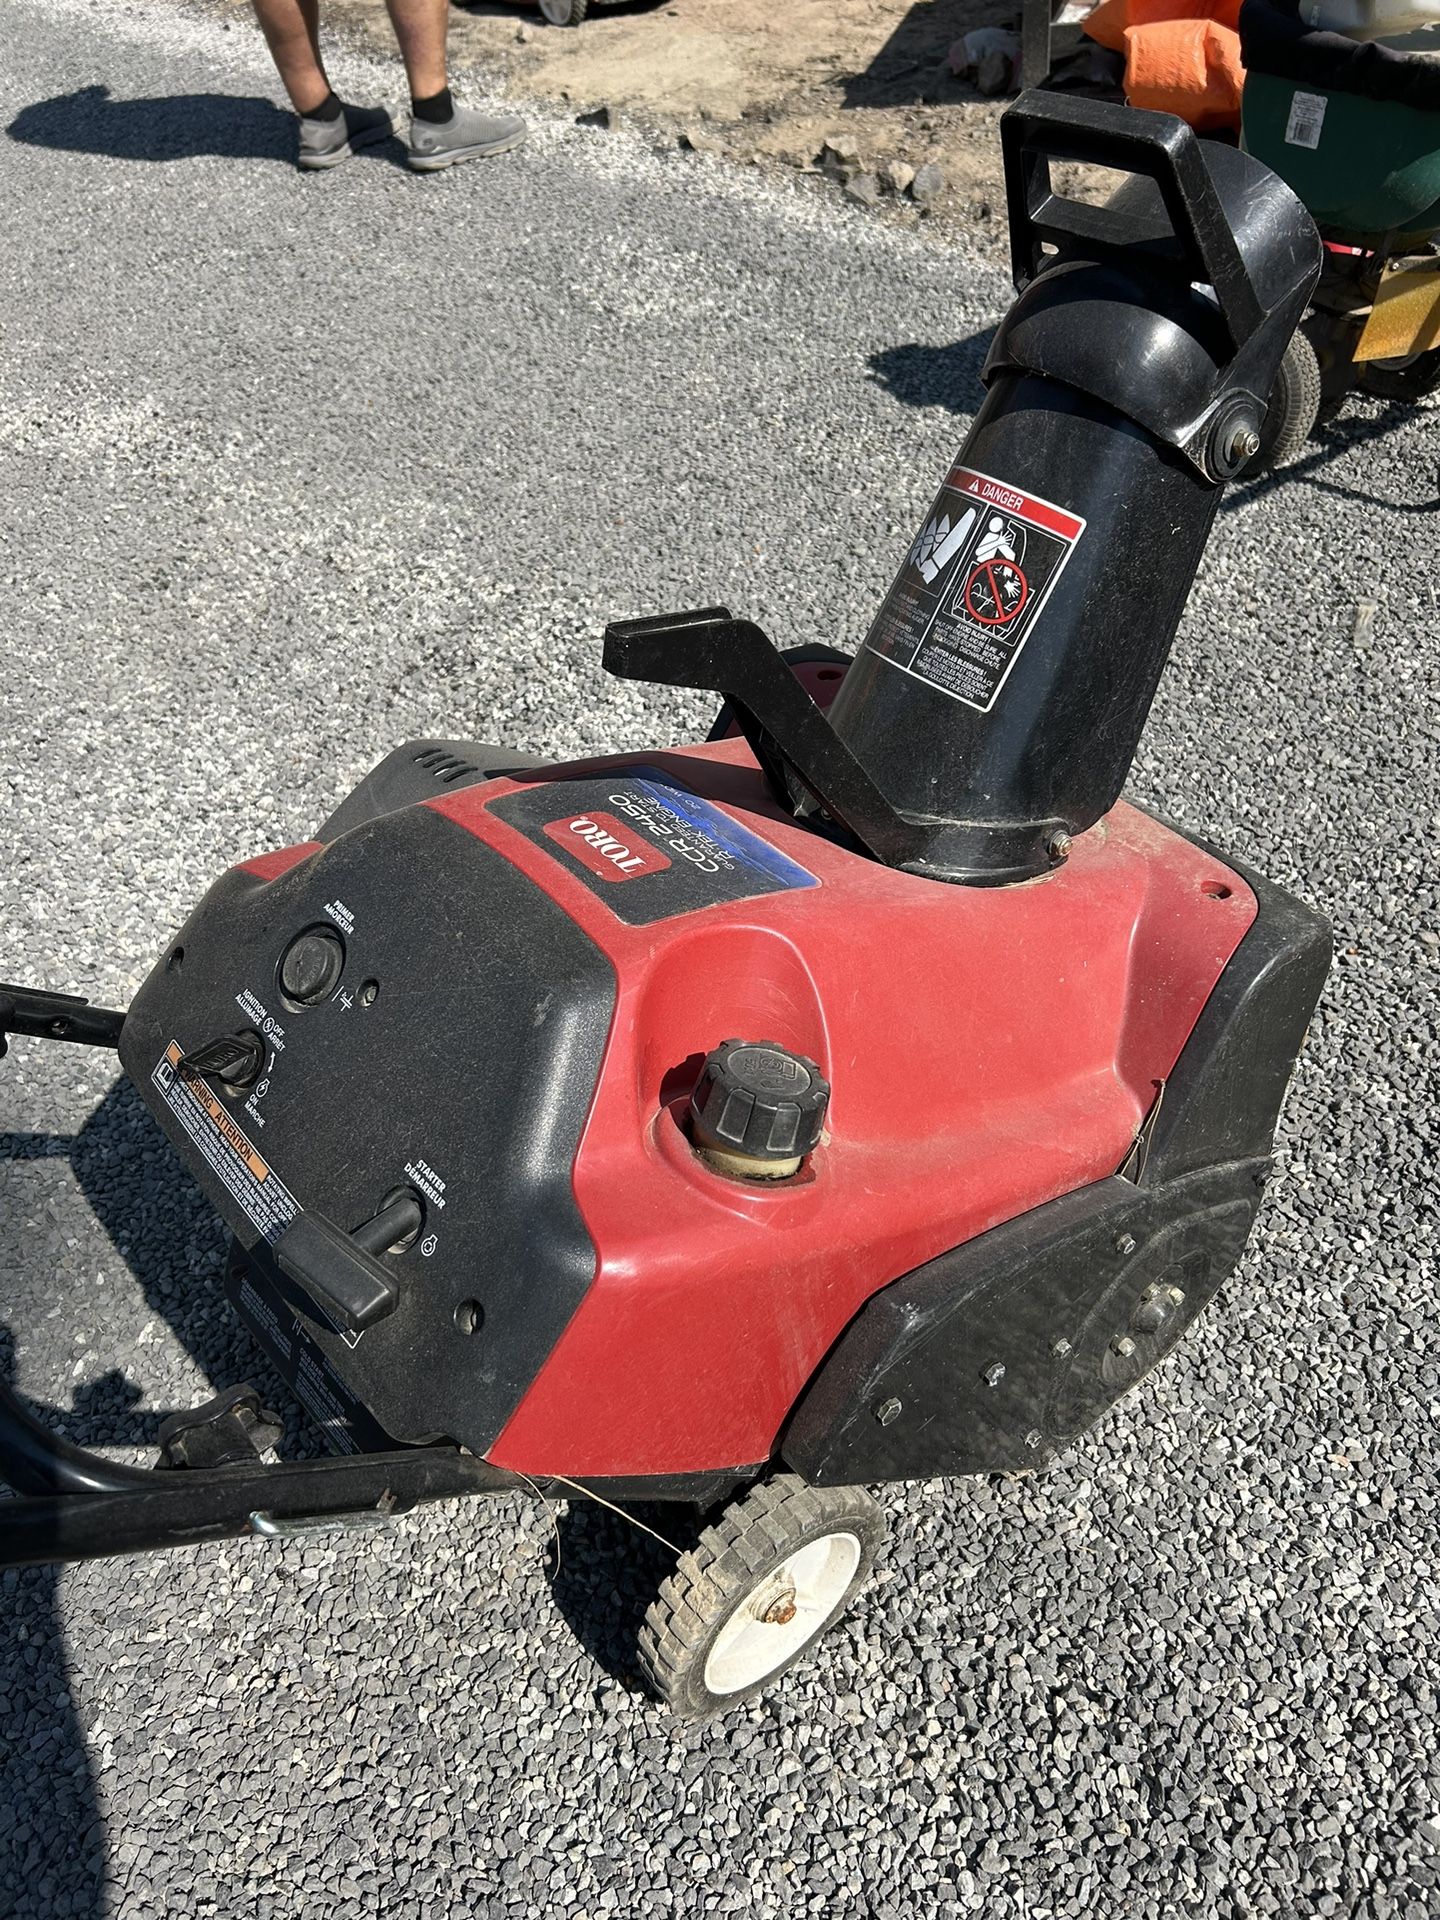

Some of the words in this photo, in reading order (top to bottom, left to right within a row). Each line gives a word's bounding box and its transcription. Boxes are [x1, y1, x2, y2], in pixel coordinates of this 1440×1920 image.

[980, 482, 1025, 511] DANGER
[608, 794, 673, 836] 2450
[623, 789, 658, 813] START
[642, 796, 693, 828] ENGINE
[569, 819, 647, 873] TORO
[668, 838, 720, 872] CCR
[670, 823, 735, 870] GUARANTEED
[332, 899, 355, 923] PRIMER
[234, 993, 262, 1026] ALLUMAGE
[242, 988, 268, 1018] IGNITION
[272, 1023, 286, 1037] OFF
[182, 1066, 214, 1110] WARNING
[214, 1107, 253, 1162] ATTENTION
[243, 1099, 266, 1128] MARCHE
[248, 1092, 259, 1106] ON
[415, 1158, 446, 1193] STARTER
